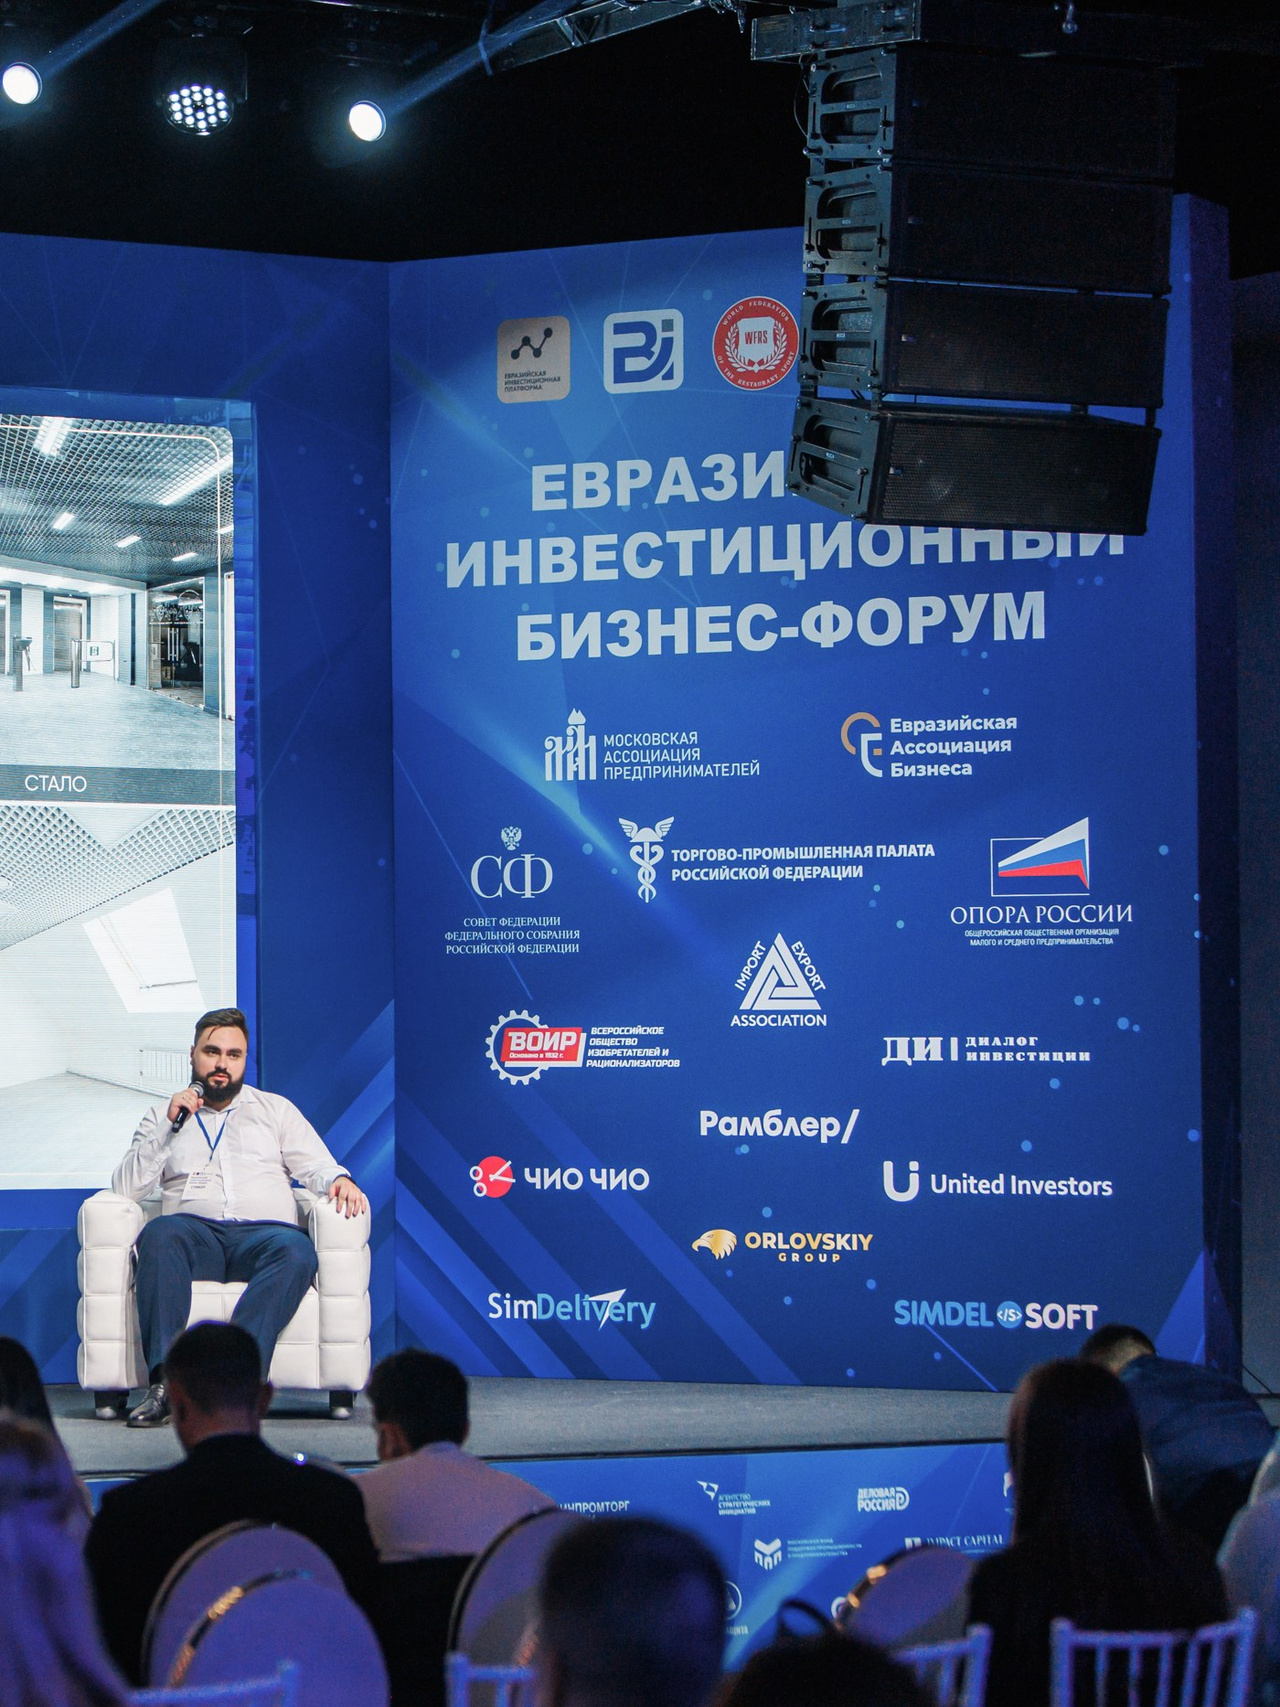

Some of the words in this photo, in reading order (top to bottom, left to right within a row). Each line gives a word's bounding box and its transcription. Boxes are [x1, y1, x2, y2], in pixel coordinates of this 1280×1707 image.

[722, 304, 744, 326] WORLD
[748, 300, 790, 322] FEDERATION
[744, 330, 768, 345] WFRS
[717, 354, 725, 365] OF
[723, 367, 735, 380] THE
[737, 374, 779, 387] RESTAURANT
[781, 351, 795, 372] SPORT
[504, 384, 543, 392] ПЛАТФОРМА
[531, 451, 785, 511] ЕВРАЗИ
[518, 591, 1045, 661] БИЗНЕС-ФОРУМ
[891, 715, 1017, 735] Евразийская
[604, 732, 697, 747] МОСКОВСКАЯ
[890, 740, 1011, 755] Ассоциация
[603, 748, 701, 764] АССОЦИАЦИЯ
[604, 759, 759, 781] ПРЕДПРИНИМАТЕЛЕЙ
[891, 763, 972, 777] Бизнеса
[25, 775, 87, 792] СТАЛО
[672, 846, 873, 861] ТОРГОВО-ПРОМЫШЛЕННАЯ
[877, 844, 935, 857] ПАЛАТА
[471, 854, 553, 898] СФ
[672, 865, 769, 881] РОССИЙСКОЙ
[773, 866, 863, 881] ФЕДЕРАЦИИ
[464, 918, 497, 926] СОВЕТ
[499, 917, 560, 927] ФЕДЕРАЦИИ
[951, 906, 1030, 924] ОПОРА
[1036, 905, 1132, 923] РОССИИ
[445, 931, 524, 941] ФЕДЕРАЛЬНОГО
[527, 930, 579, 939] СОБРАНИЯ
[447, 943, 515, 954] РОССИЙСКОЙ
[518, 944, 579, 954] ФЕДЕРАЦИИ
[734, 940, 767, 992] IMPORT
[790, 940, 827, 992] EXPORT
[731, 1015, 826, 1026] ASSOCIATION
[591, 1025, 664, 1034] ВСЕРОССИЙСКОЕ
[508, 1031, 577, 1051] ВОИР
[590, 1038, 638, 1046] ОБЩЕСТВО
[966, 1037, 1038, 1047] ДИАЛОГ
[588, 1047, 660, 1056] ИЗОБРЕТАТЕЛЕЙ
[882, 1037, 943, 1066] ДИ
[967, 1052, 1090, 1062] ИНВЕСТИЦИИ
[586, 1060, 680, 1068] РАЦИОНАЛИЗАТОРОВ
[525, 1168, 583, 1190] ЧИО
[590, 1168, 649, 1190] ЧИО
[931, 1173, 1004, 1194] United
[1011, 1175, 1112, 1195] Investors
[745, 1232, 873, 1250] ORLOVSKIY
[779, 1253, 840, 1262] GROUP
[488, 1291, 657, 1330] SimDelivery
[894, 1300, 994, 1328] SIMDEL
[1025, 1303, 1099, 1330] SOFT
[858, 1487, 896, 1499] ДЕЛОВАЯ
[559, 1500, 630, 1513] ИНПРОМТОРГ
[857, 1498, 896, 1512] РОССИЯ
